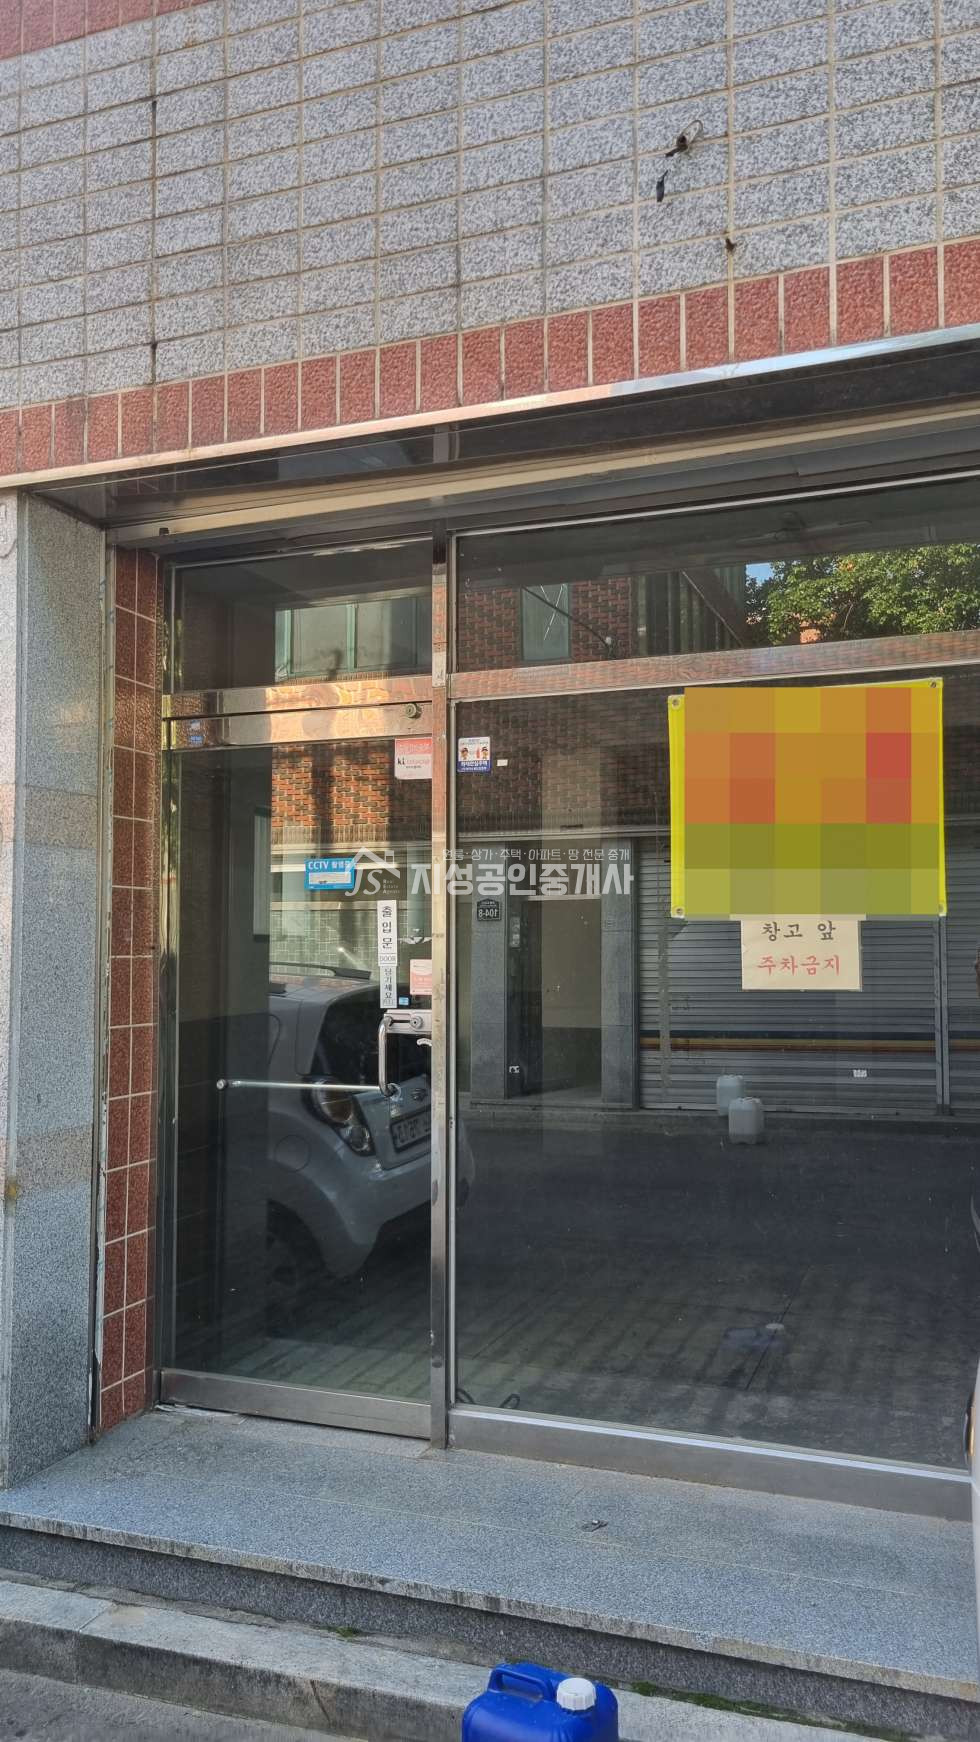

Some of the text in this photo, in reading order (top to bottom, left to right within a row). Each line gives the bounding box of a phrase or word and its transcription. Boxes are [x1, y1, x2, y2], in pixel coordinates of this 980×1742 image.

[308, 861, 329, 870] CCTV
[382, 905, 392, 949] 출입문
[761, 920, 837, 942] 창고 앞
[757, 954, 840, 977] 주차금지
[384, 967, 393, 999] 당기세요
